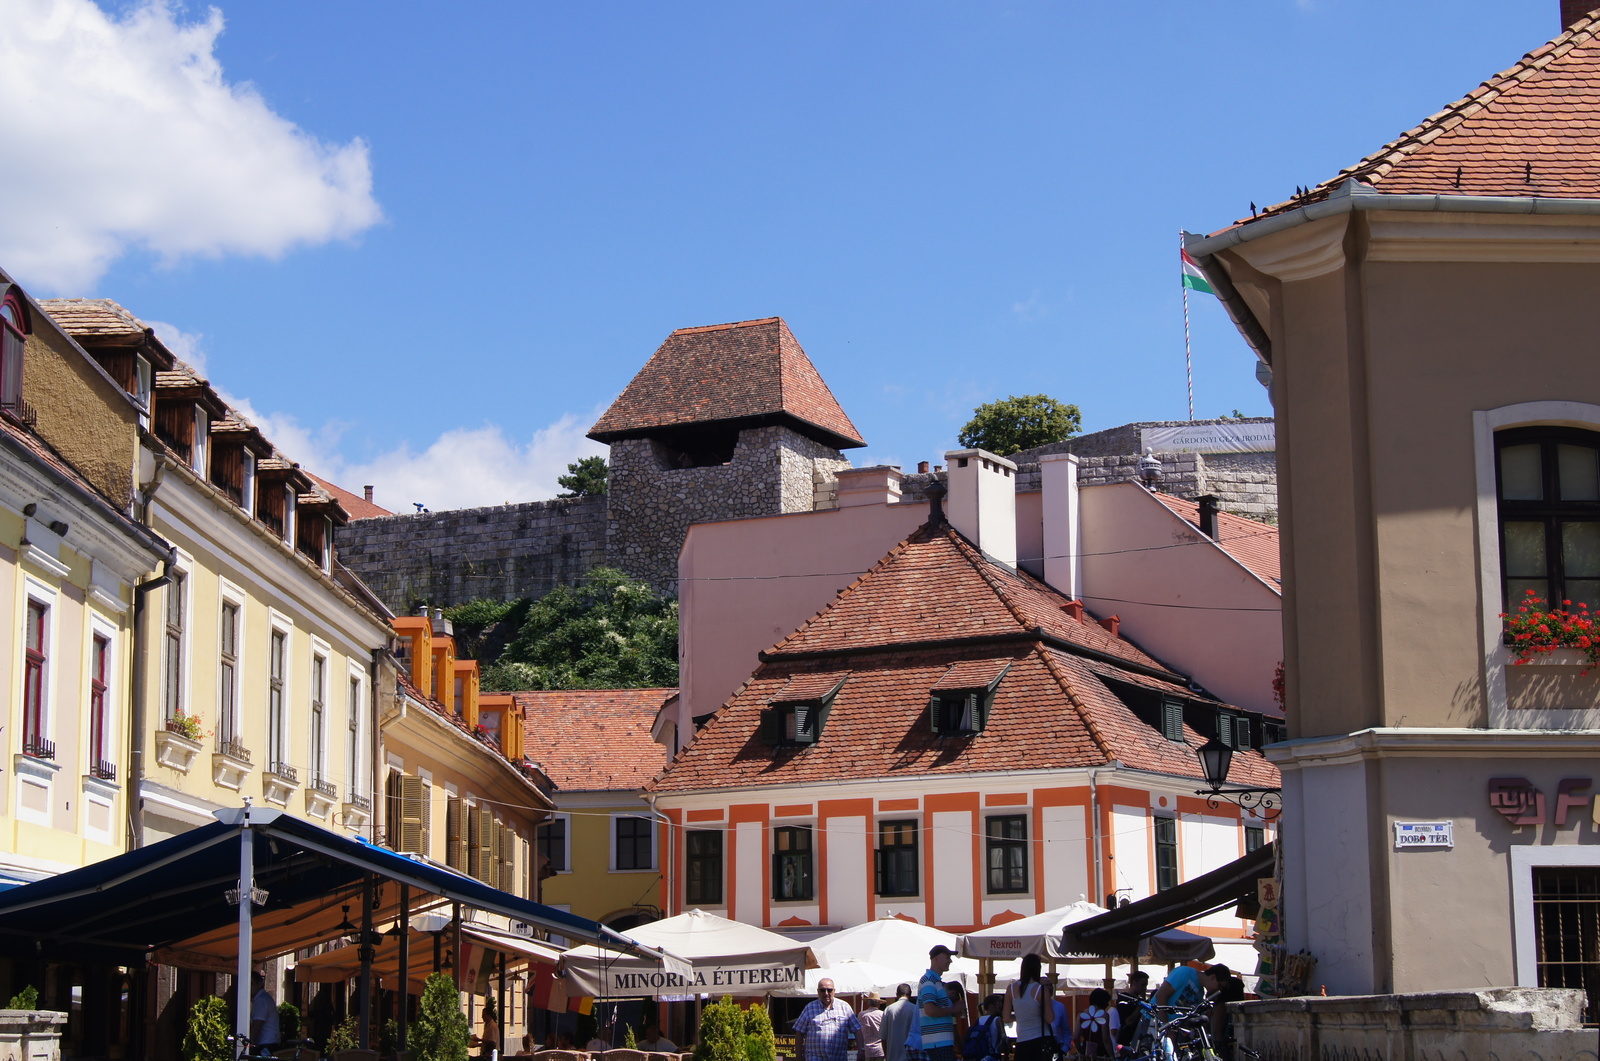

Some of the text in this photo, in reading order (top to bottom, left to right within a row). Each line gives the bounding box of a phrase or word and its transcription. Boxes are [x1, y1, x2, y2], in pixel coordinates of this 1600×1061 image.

[1173, 436, 1217, 445] GÁRDONYI
[1400, 833, 1449, 844] DOBÓ TÉR
[991, 940, 1021, 949] Rexroth
[712, 966, 800, 986] ÉTTEREM
